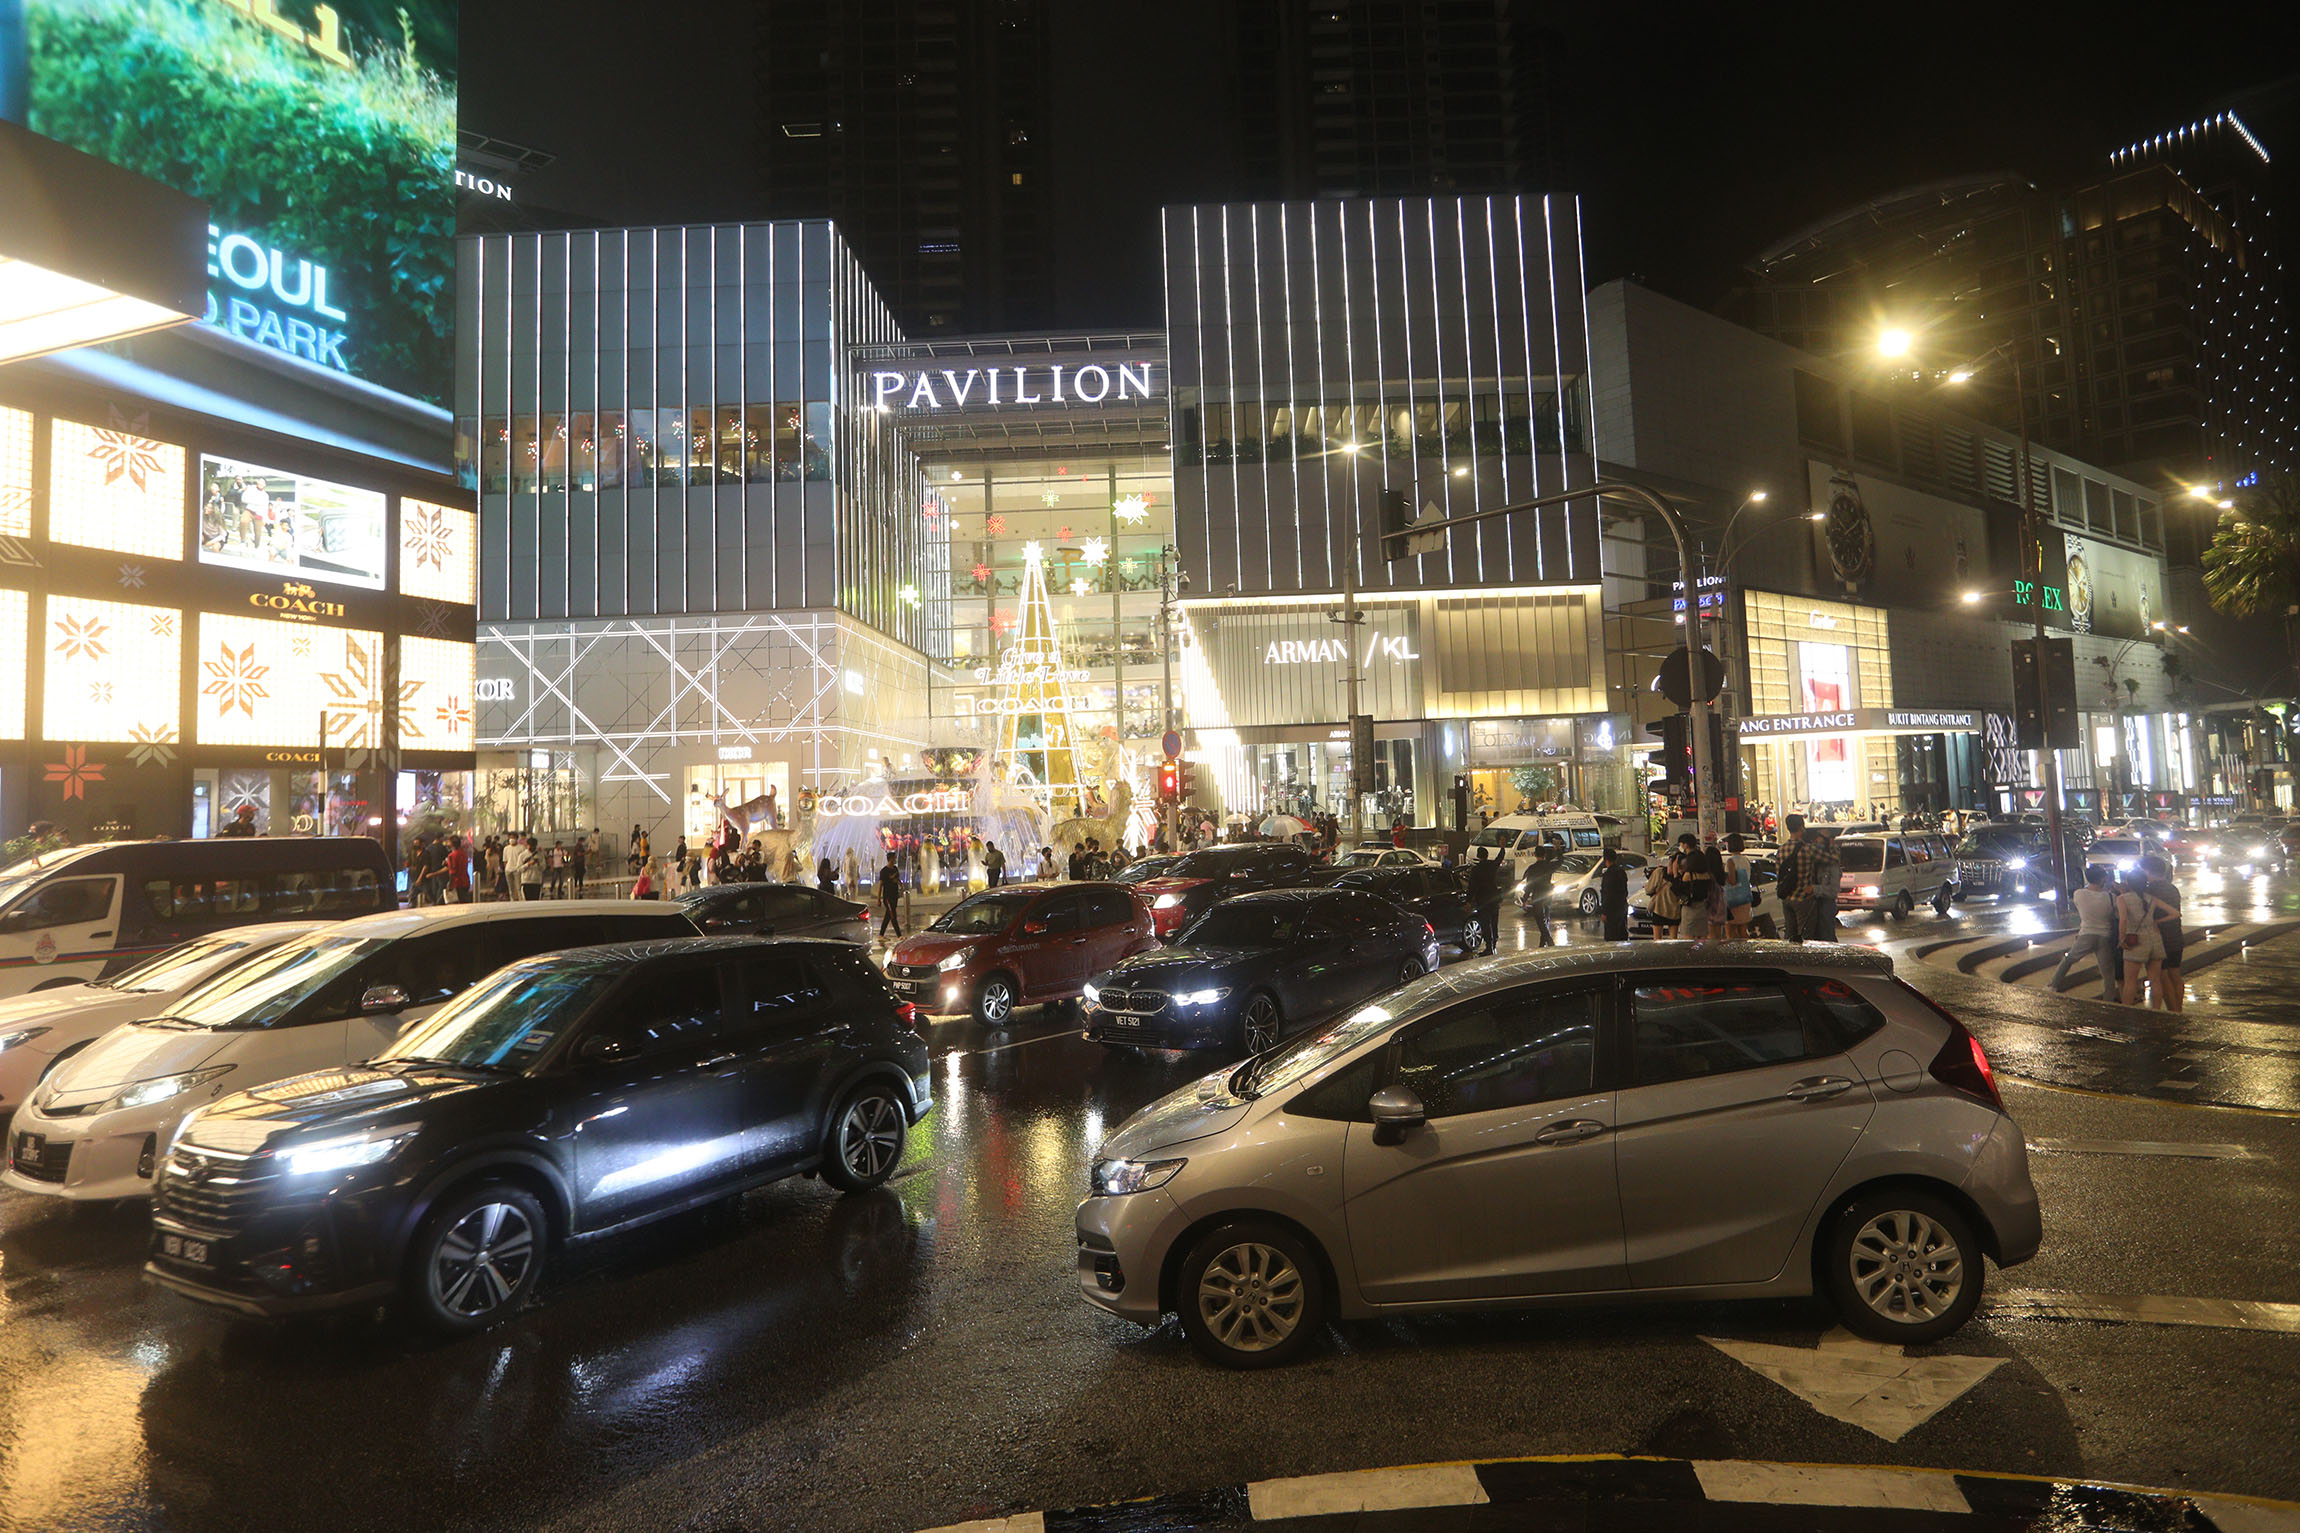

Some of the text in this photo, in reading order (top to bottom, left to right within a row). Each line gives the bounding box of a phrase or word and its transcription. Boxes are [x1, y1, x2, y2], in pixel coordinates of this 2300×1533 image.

[228, 297, 348, 371] PARK
[872, 362, 1152, 412] PAVILION
[249, 593, 345, 617] COACH
[280, 612, 317, 622] NEW YORK
[1034, 665, 1091, 682] Love
[977, 696, 1091, 714] COACH
[1773, 713, 1856, 732] ENTRANCE
[1888, 712, 1972, 726] BUKIT BINTANG ENTRANCE
[817, 790, 969, 817] COACH
[1115, 1015, 1127, 1026] VET
